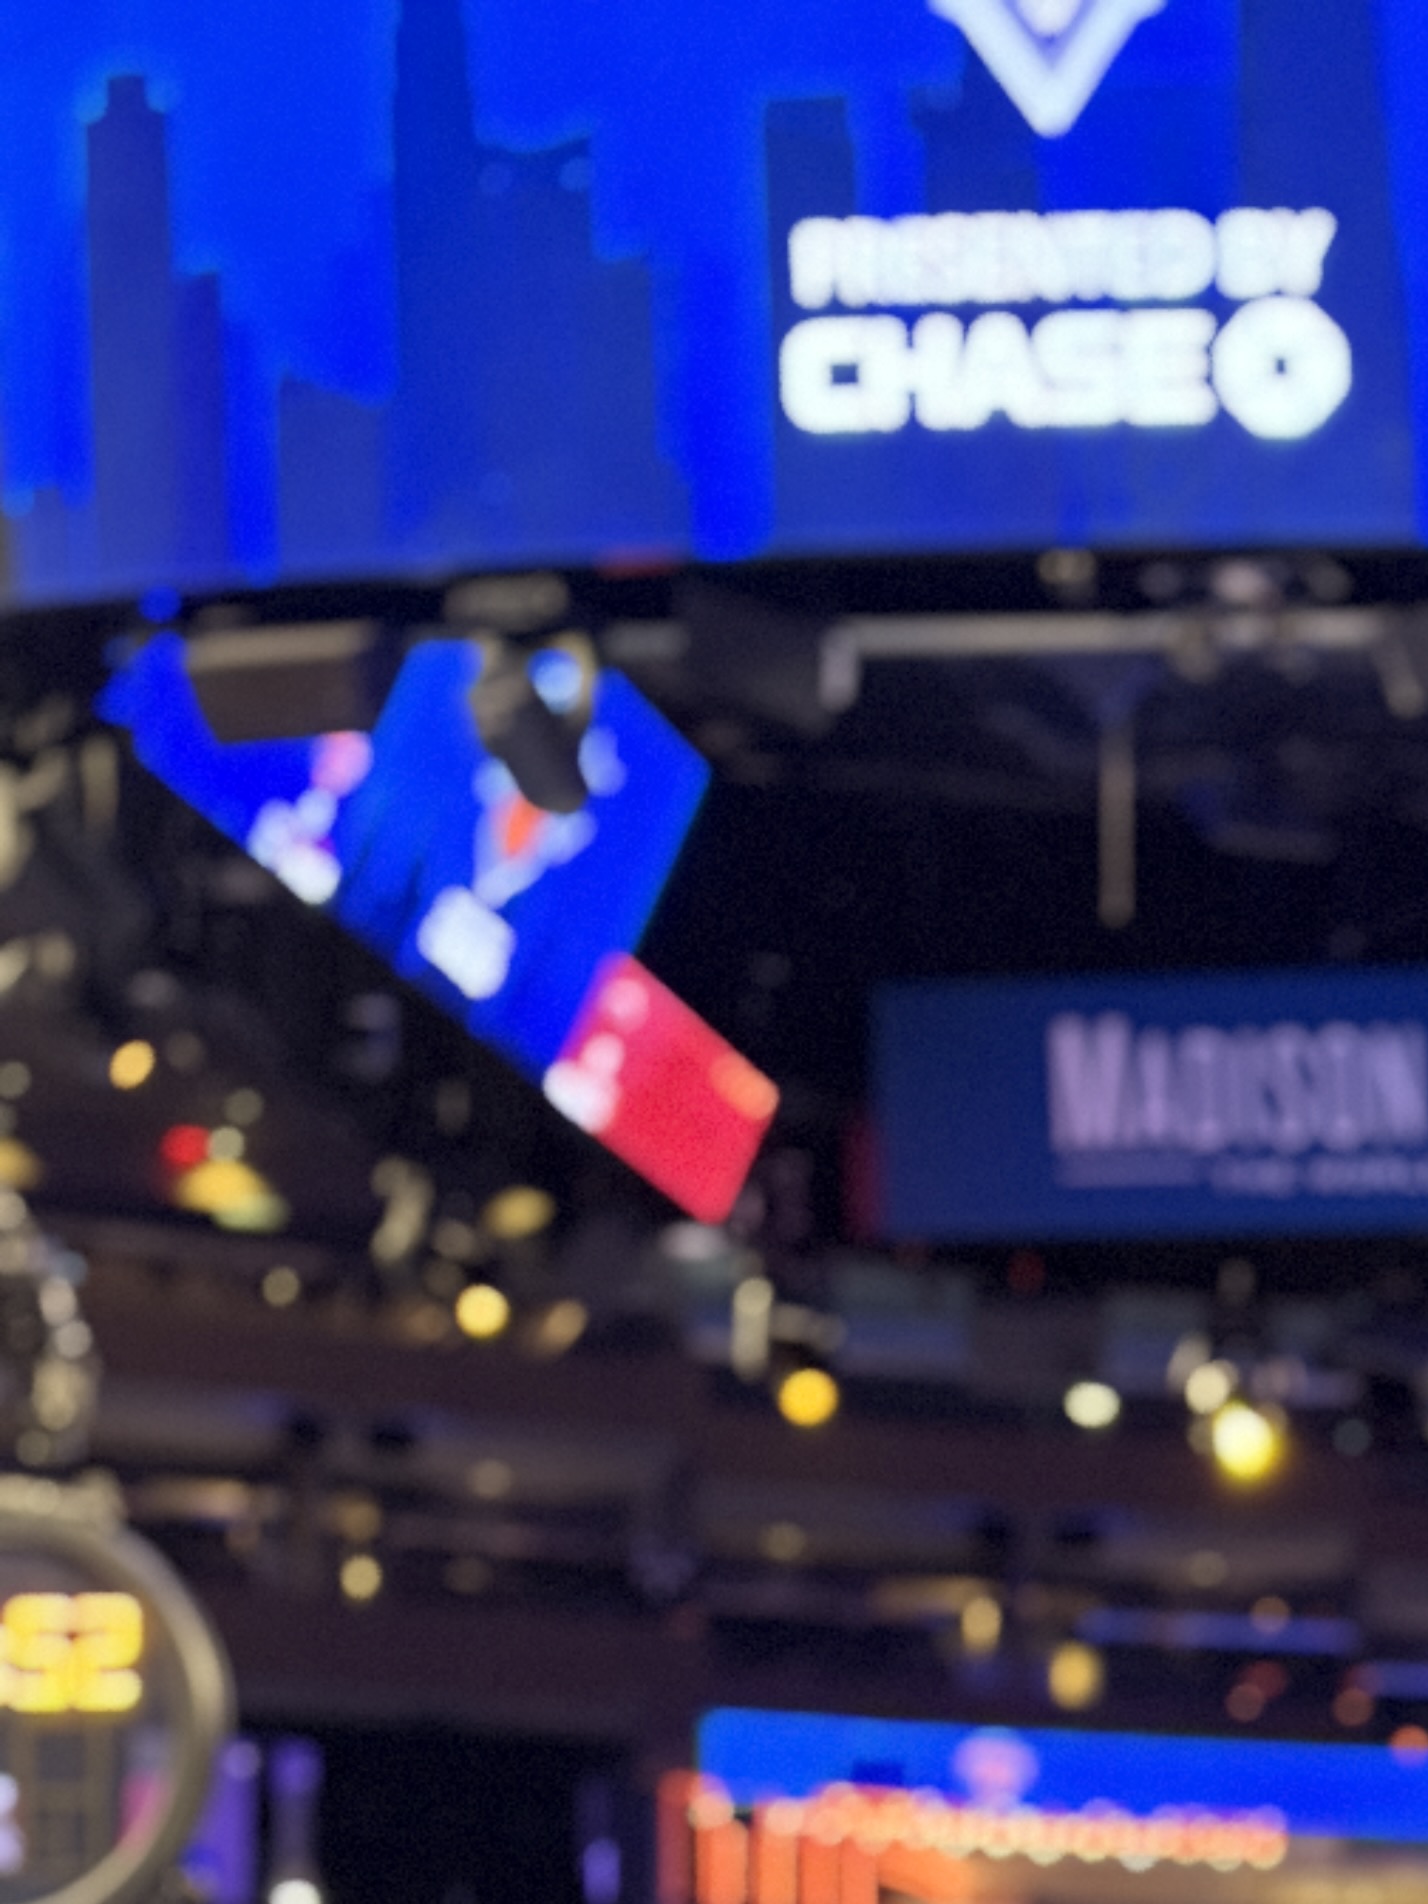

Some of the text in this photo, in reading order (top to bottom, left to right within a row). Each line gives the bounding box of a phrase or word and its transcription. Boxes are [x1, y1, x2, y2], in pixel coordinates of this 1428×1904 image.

[788, 206, 1337, 308] PRESENTED BY
[780, 309, 1219, 433] CHASE
